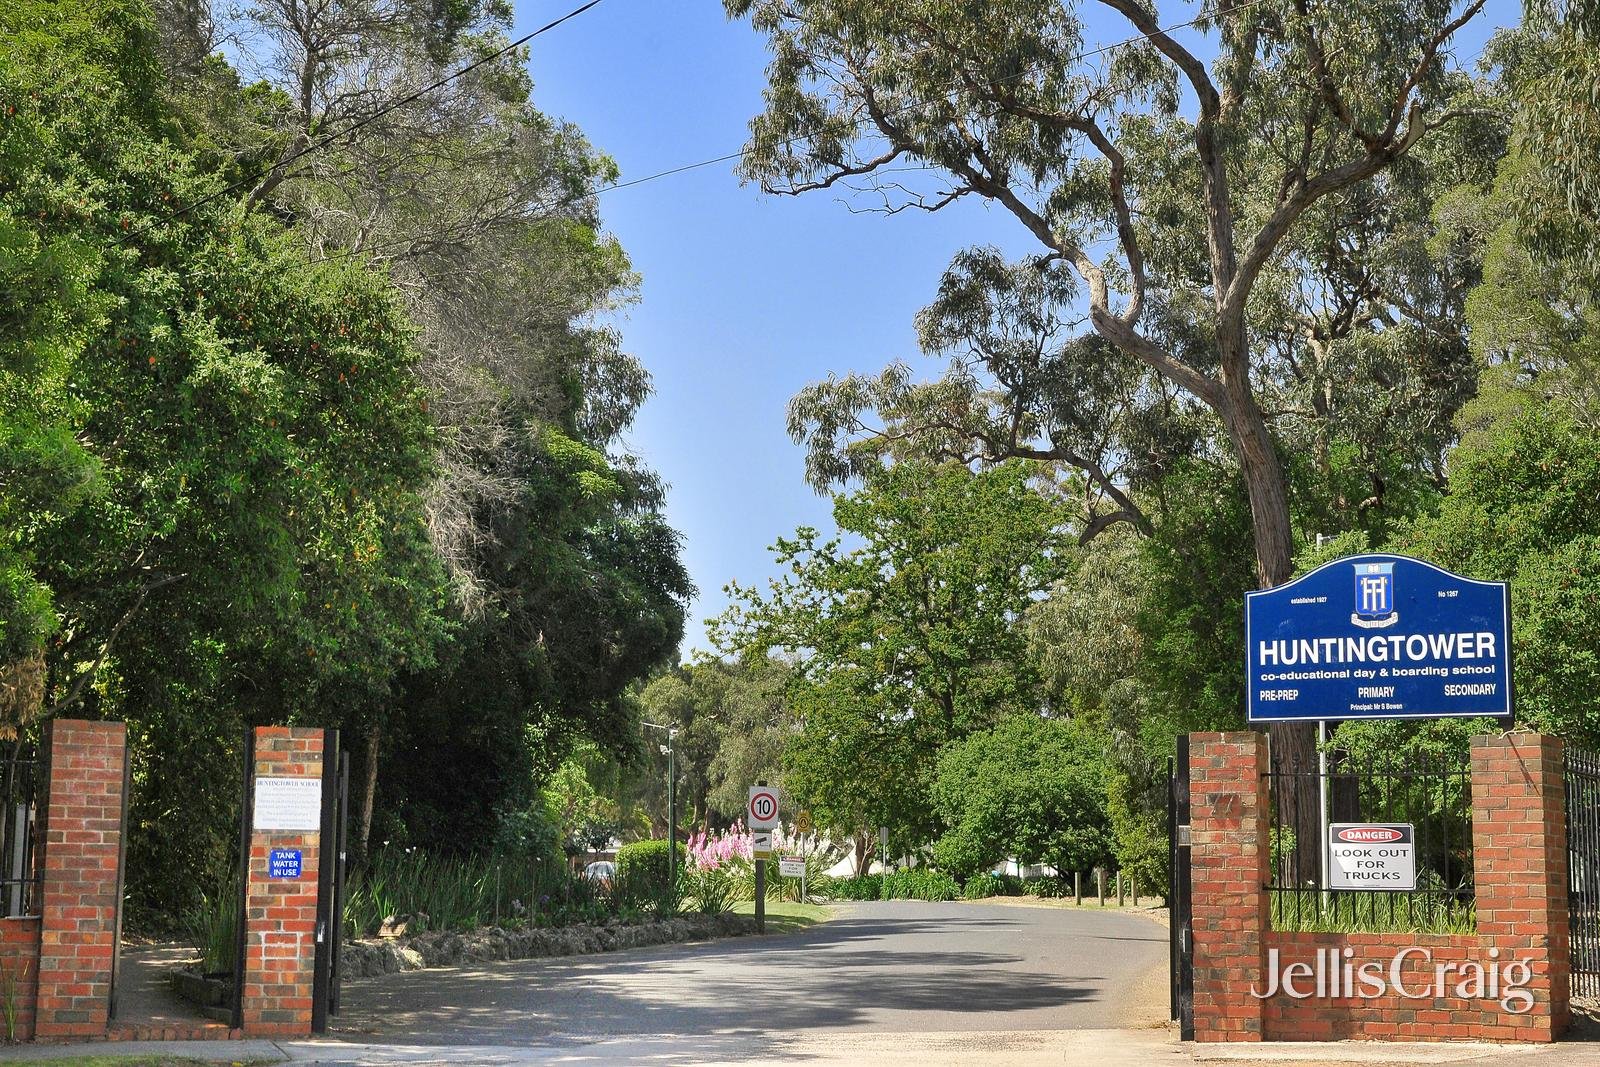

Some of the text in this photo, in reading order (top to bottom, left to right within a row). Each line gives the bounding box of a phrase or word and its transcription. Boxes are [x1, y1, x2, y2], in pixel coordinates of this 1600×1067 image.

[1437, 590, 1445, 598] No
[1259, 631, 1496, 666] HUNTINGTOWER
[1260, 665, 1495, 682] co-educational day & boarding school
[1259, 689, 1299, 701] PRE-PREP
[1358, 686, 1395, 698] PRIMARY
[1444, 684, 1496, 697] SECONDARY
[1350, 703, 1373, 711] Principal:
[757, 799, 771, 815] 10
[1346, 831, 1393, 840] DANGER
[1334, 849, 1409, 857] LOOK OUT
[1343, 872, 1401, 880] TRUCKS
